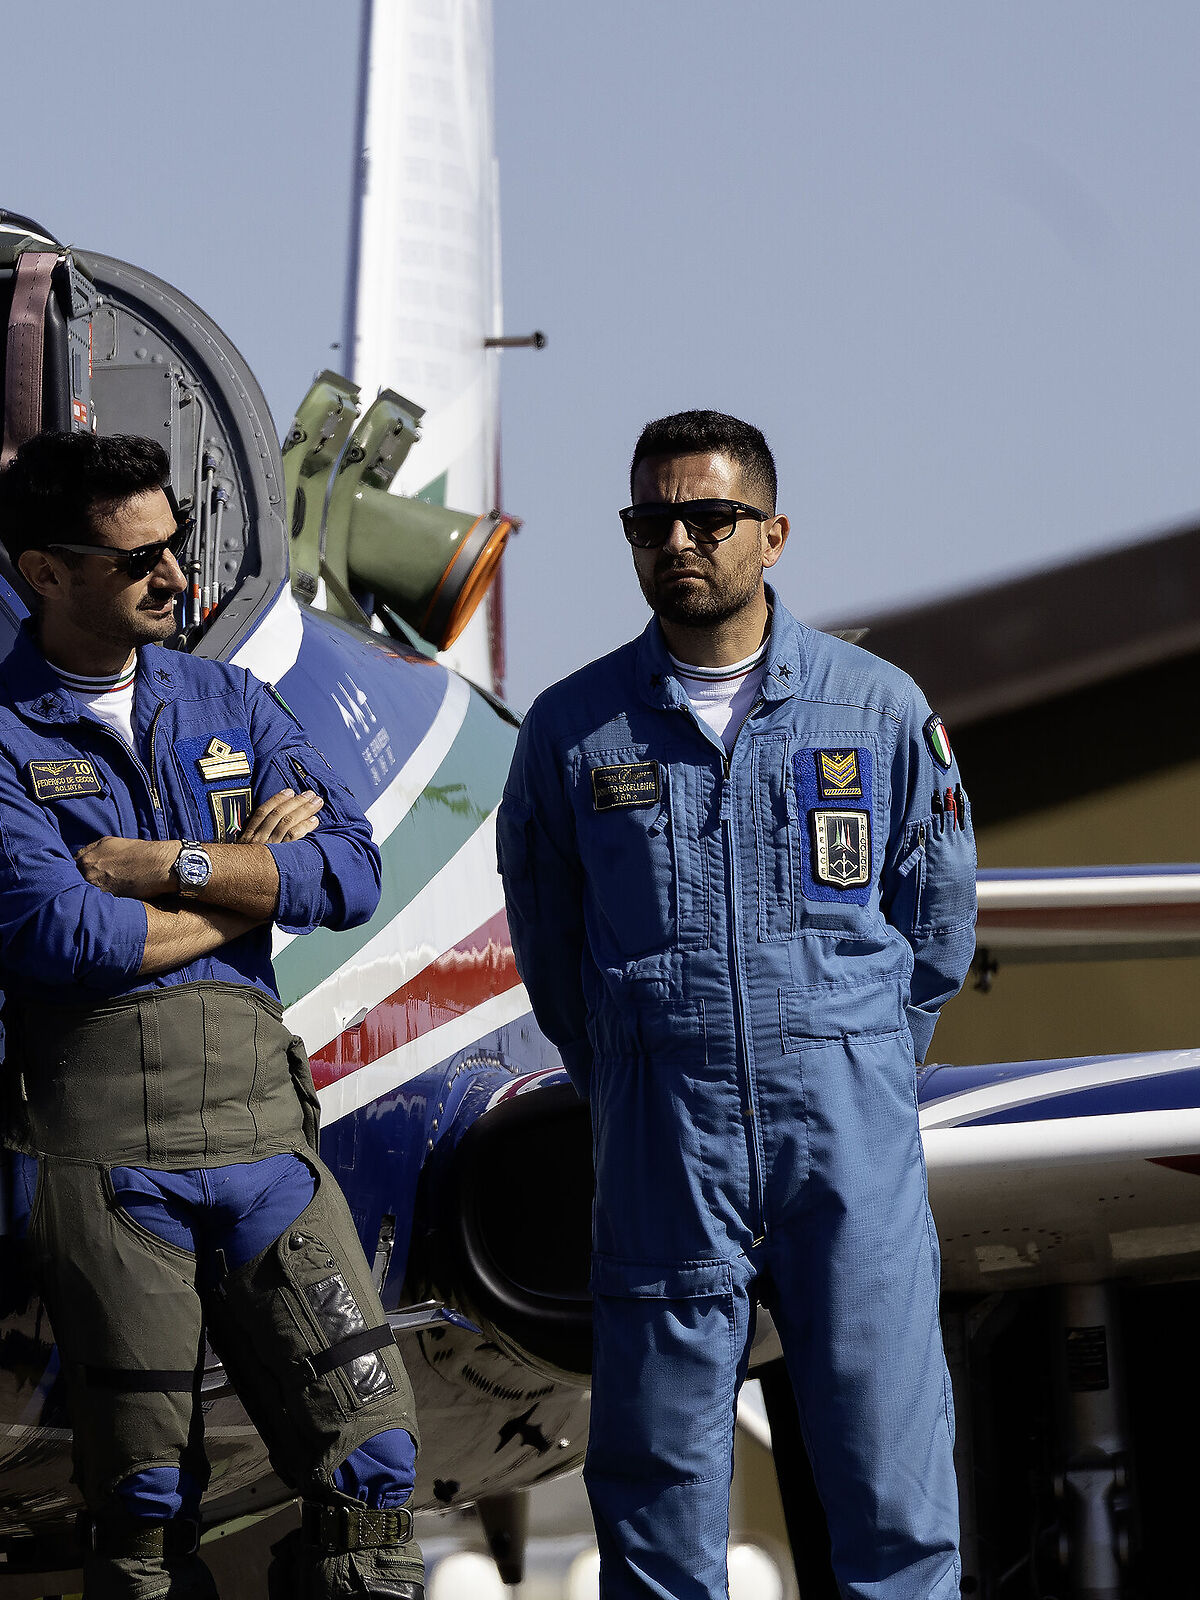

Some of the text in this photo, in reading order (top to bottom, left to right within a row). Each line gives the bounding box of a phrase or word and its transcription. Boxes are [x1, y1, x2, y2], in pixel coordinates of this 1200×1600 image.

[72, 762, 90, 775] 10
[37, 777, 66, 789] FEDERICO
[66, 776, 75, 784] DE
[818, 816, 827, 875] FRECCE
